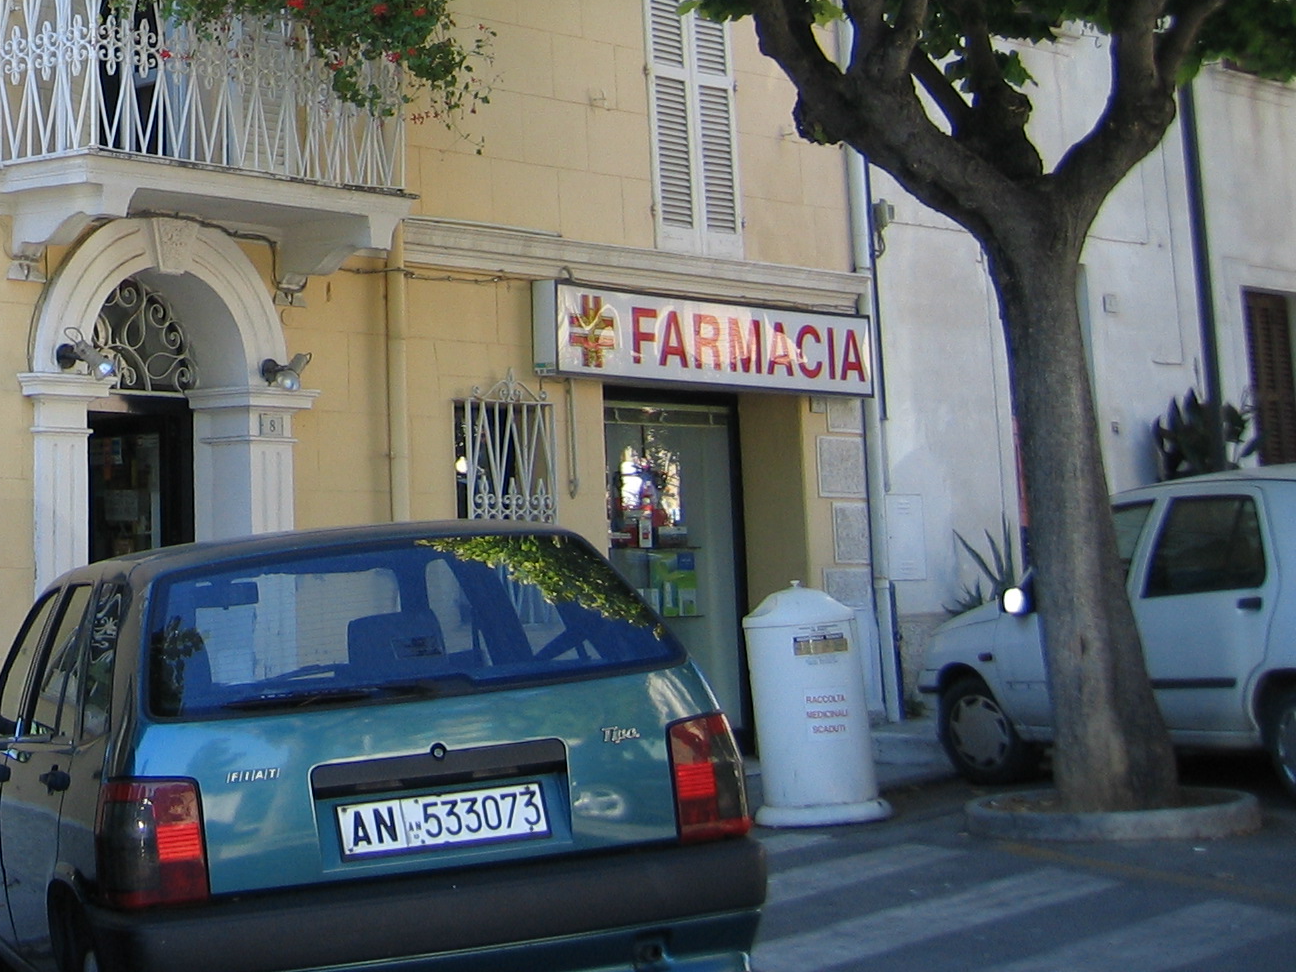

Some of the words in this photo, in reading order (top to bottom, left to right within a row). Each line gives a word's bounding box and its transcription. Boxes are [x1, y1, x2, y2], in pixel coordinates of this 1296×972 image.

[632, 306, 866, 383] FARMACIA
[269, 419, 276, 432] 8
[806, 694, 845, 703] RACCOLTA
[227, 768, 280, 783] FIAT
[353, 806, 399, 847] AN
[422, 790, 542, 838] 533073
